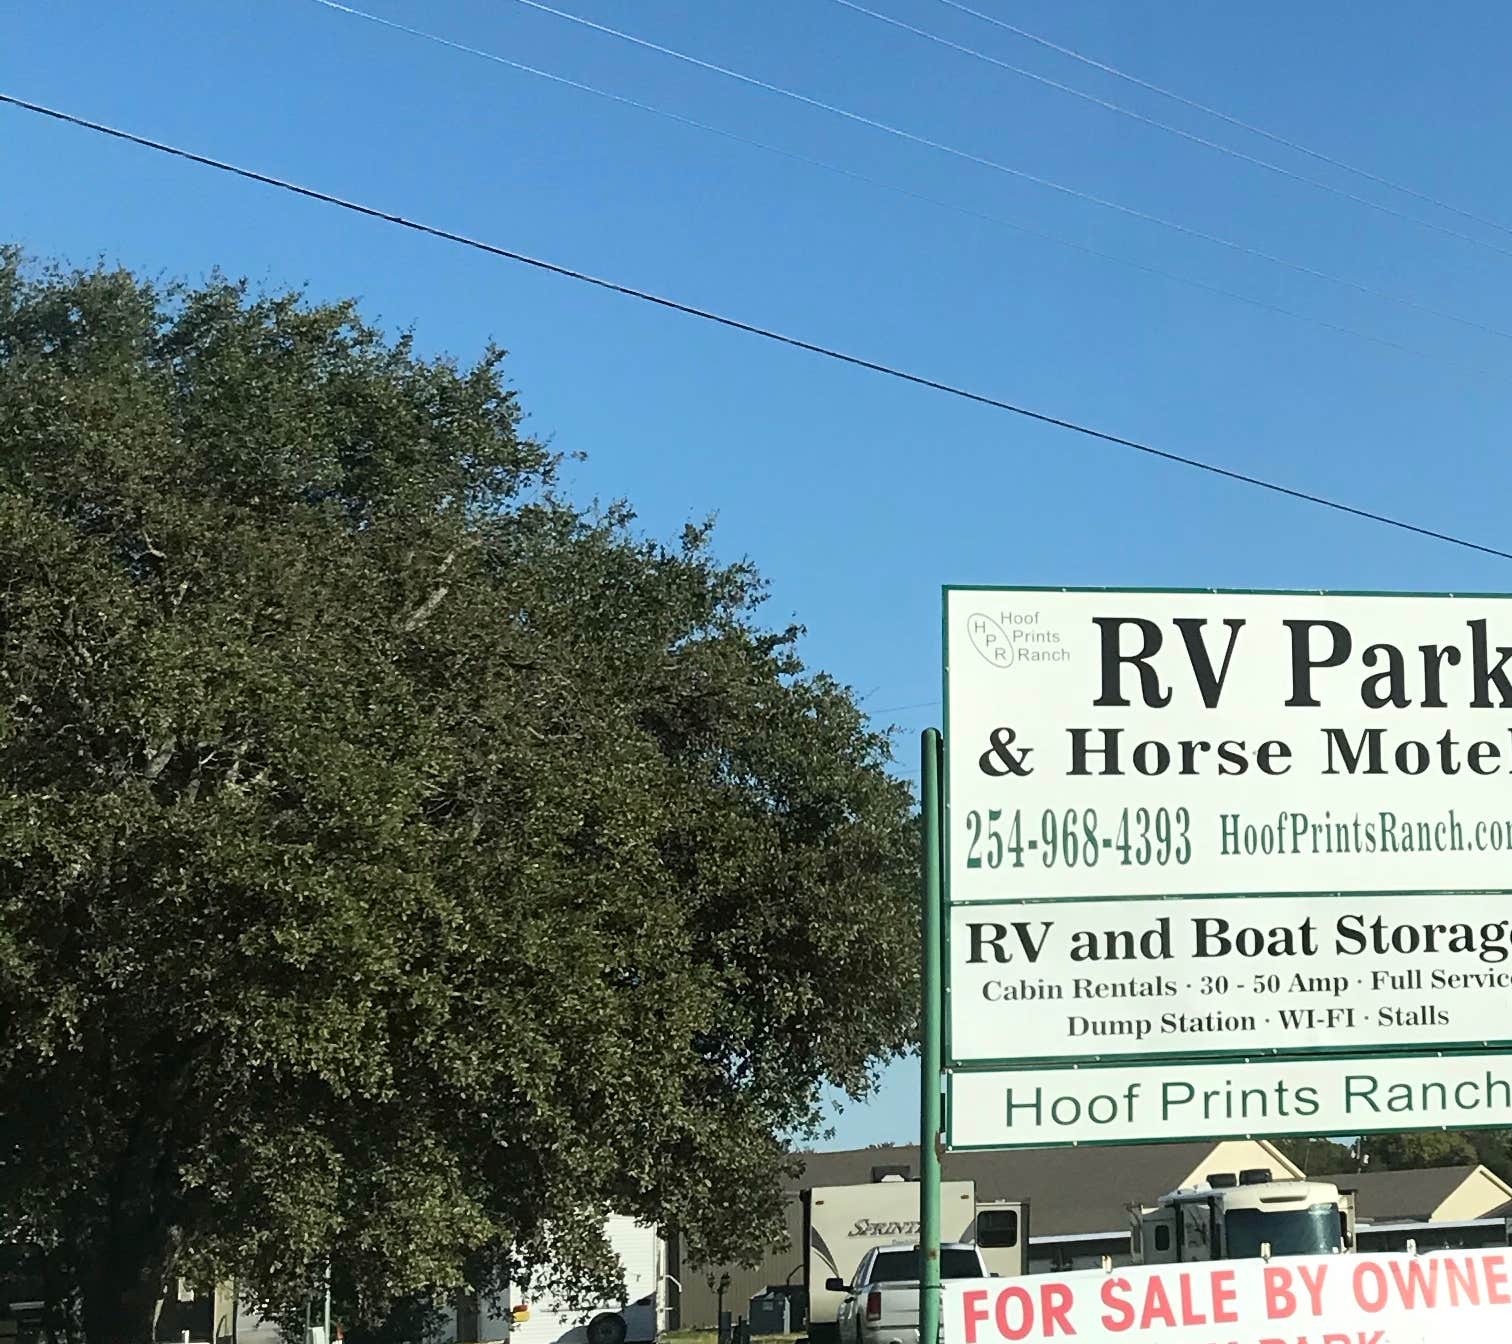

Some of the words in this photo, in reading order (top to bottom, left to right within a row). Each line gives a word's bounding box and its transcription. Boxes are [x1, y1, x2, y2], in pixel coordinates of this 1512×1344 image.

[1001, 611, 1040, 624] Hoof
[1013, 629, 1061, 643] Prints
[1018, 648, 1071, 661] Ranch
[1091, 616, 1247, 708] RV
[978, 726, 1034, 777] &
[1065, 727, 1292, 777] Horse
[966, 806, 1192, 869] 254-968-4393
[965, 920, 1055, 964] RV
[1069, 916, 1175, 962] and
[1191, 915, 1319, 959] Boat
[982, 978, 1064, 1002] Cabin
[1072, 974, 1178, 999] Rentals
[1200, 974, 1229, 996] 30
[1252, 973, 1281, 995] 50
[1287, 972, 1349, 997] Amp
[1370, 968, 1423, 991] Full
[1066, 1015, 1152, 1040] Dump
[1160, 1011, 1256, 1034] Station
[1278, 1008, 1355, 1031] WI-FI
[1377, 1005, 1450, 1027] Stalls
[1005, 1083, 1140, 1127] Hoof
[1162, 1079, 1320, 1121] Prints
[1345, 1071, 1512, 1114] Ranch
[848, 1218, 920, 1236] SPRINT
[962, 1282, 1078, 1344] FOR
[1100, 1269, 1239, 1332] SALE
[1264, 1263, 1341, 1320] BY
